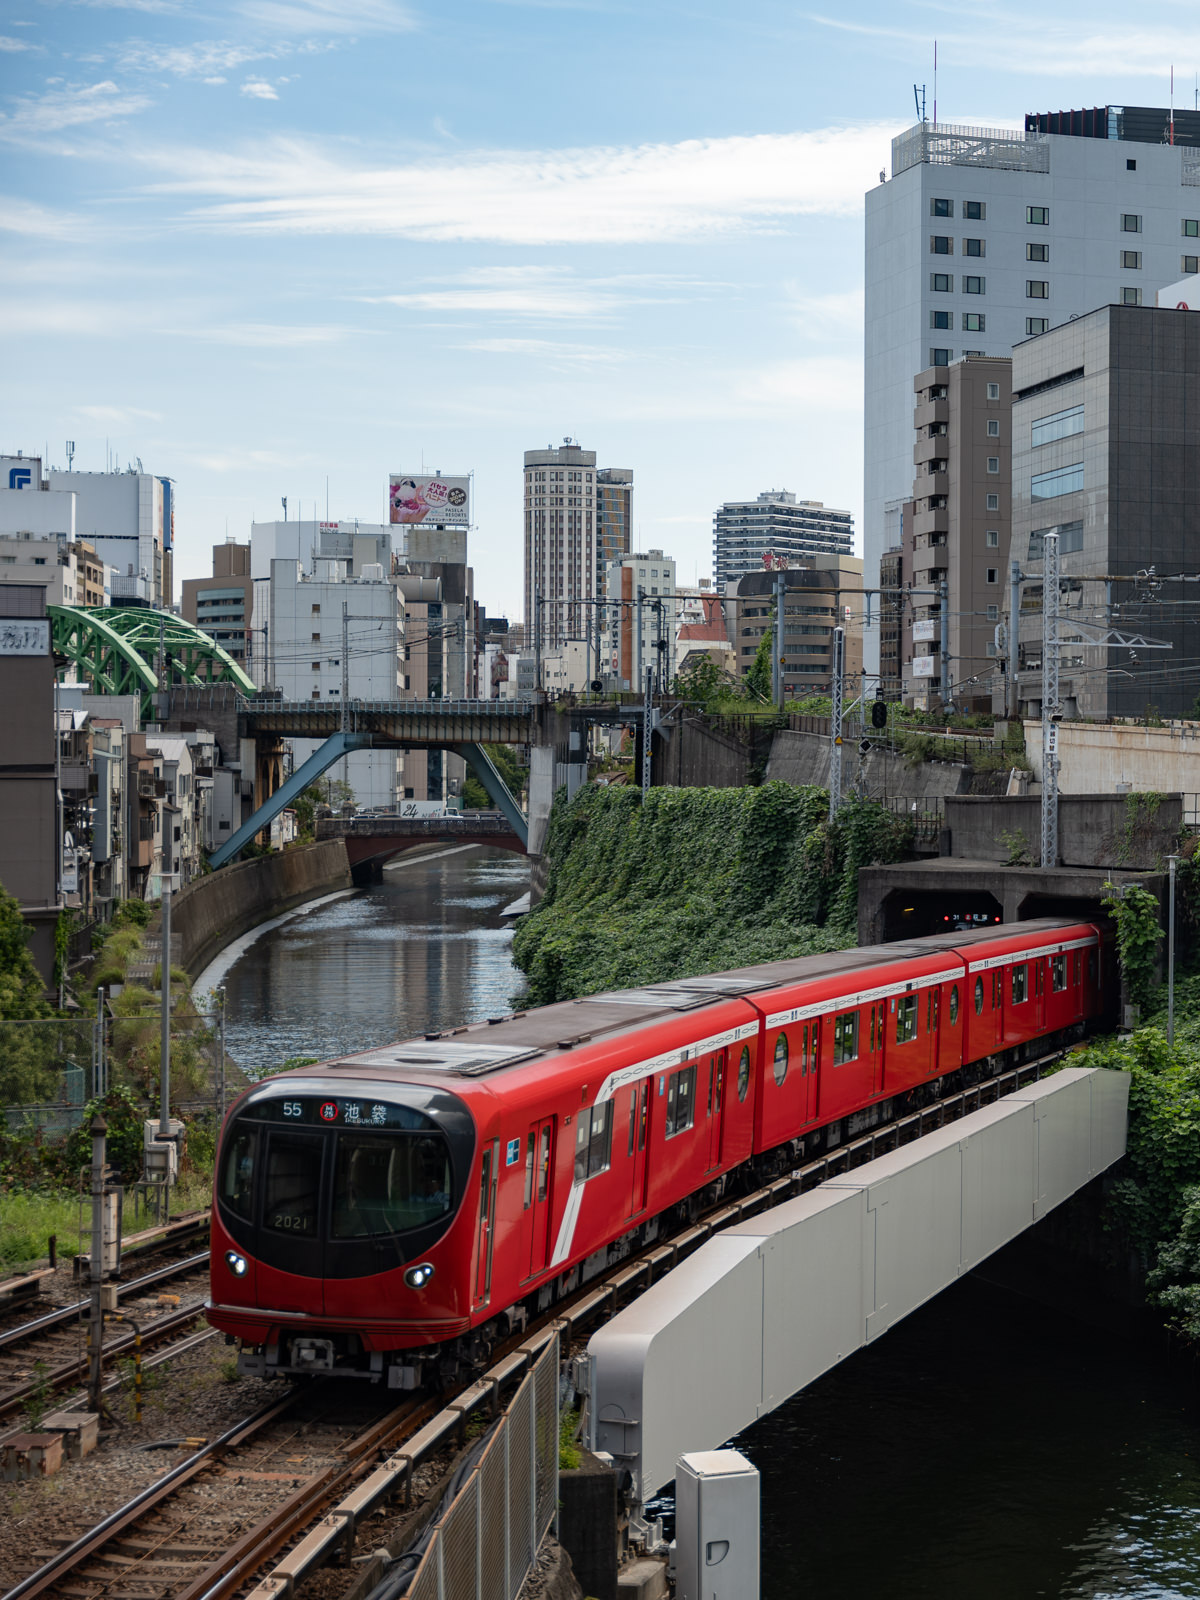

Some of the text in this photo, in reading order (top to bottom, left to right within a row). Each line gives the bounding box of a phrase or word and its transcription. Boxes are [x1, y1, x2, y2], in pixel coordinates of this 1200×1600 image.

[402, 803, 419, 818] 24
[283, 1102, 302, 1116] 55
[344, 1103, 387, 1121] 池袋
[344, 1117, 385, 1126] IKEBUKURO
[274, 1215, 307, 1230] 2021
